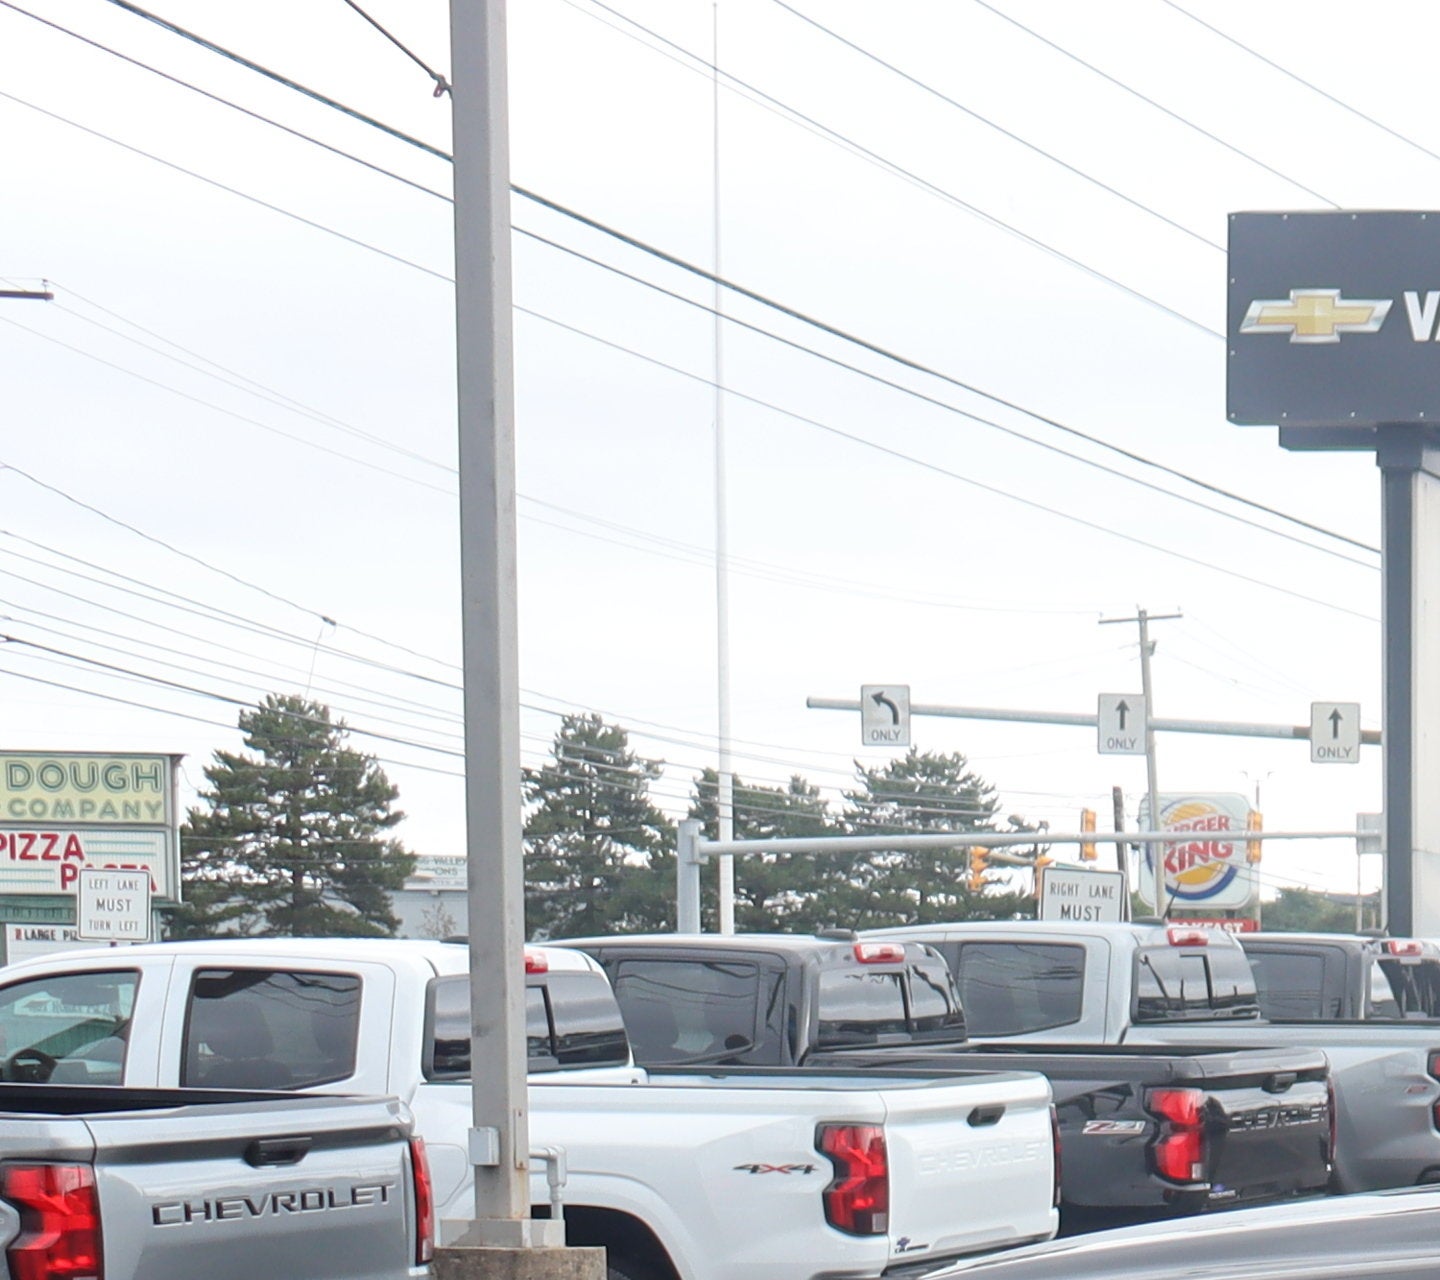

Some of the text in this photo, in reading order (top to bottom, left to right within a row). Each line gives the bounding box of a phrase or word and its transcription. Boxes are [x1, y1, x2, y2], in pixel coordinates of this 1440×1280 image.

[870, 728, 901, 742] ONLY
[1106, 737, 1137, 751] ONLY
[1316, 745, 1353, 760] ONLY
[6, 760, 162, 793] DOUGH
[7, 797, 163, 820] COMPANY
[89, 878, 139, 891] LEFT LANE
[1050, 882, 1114, 899] RIGHT LANE
[96, 898, 133, 912] MUST
[1060, 904, 1102, 921] MUST
[89, 919, 139, 932] TURN LEFT
[24, 928, 56, 941] LARGE
[63, 929, 79, 941] PIZ
[152, 1182, 396, 1226] CHEVROLET
